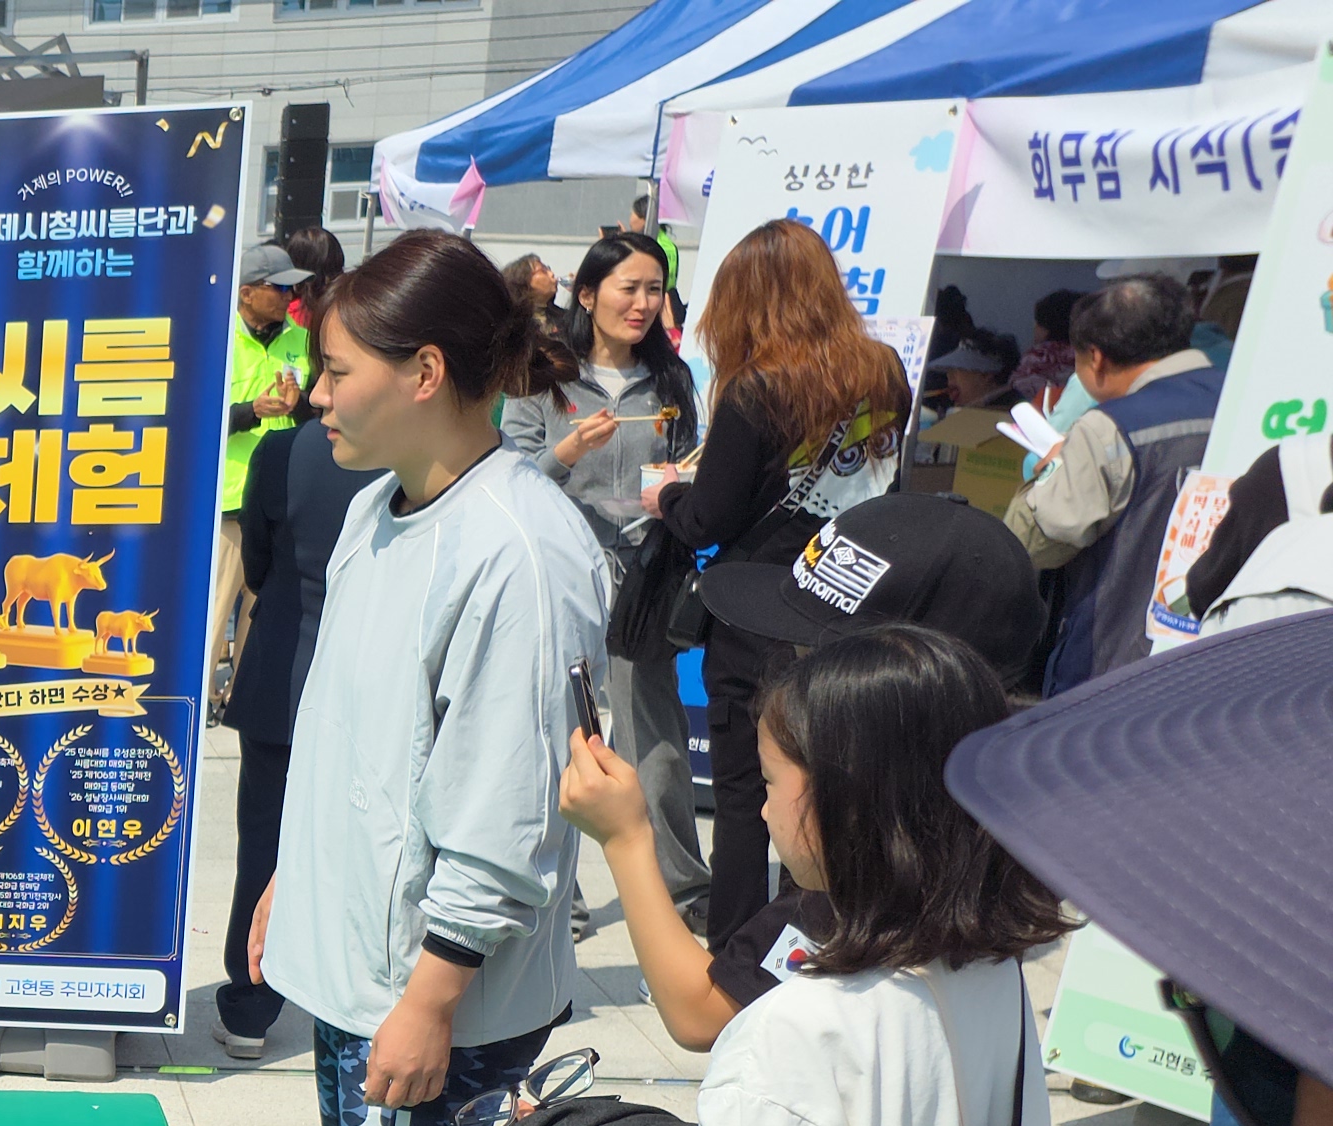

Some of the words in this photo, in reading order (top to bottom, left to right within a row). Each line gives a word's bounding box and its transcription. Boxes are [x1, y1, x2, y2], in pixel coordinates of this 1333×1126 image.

[17, 169, 61, 202] 거제의
[65, 167, 134, 199] POWER!!
[784, 161, 875, 192] 싱싱한
[786, 206, 871, 254] 어
[17, 248, 135, 280] 함께하는
[29, 685, 65, 705] 하면
[72, 682, 110, 703] 수상
[5, 979, 55, 997] 고현동
[60, 981, 146, 1000] 주민자치회
[1148, 1046, 1196, 1076] 고현동
